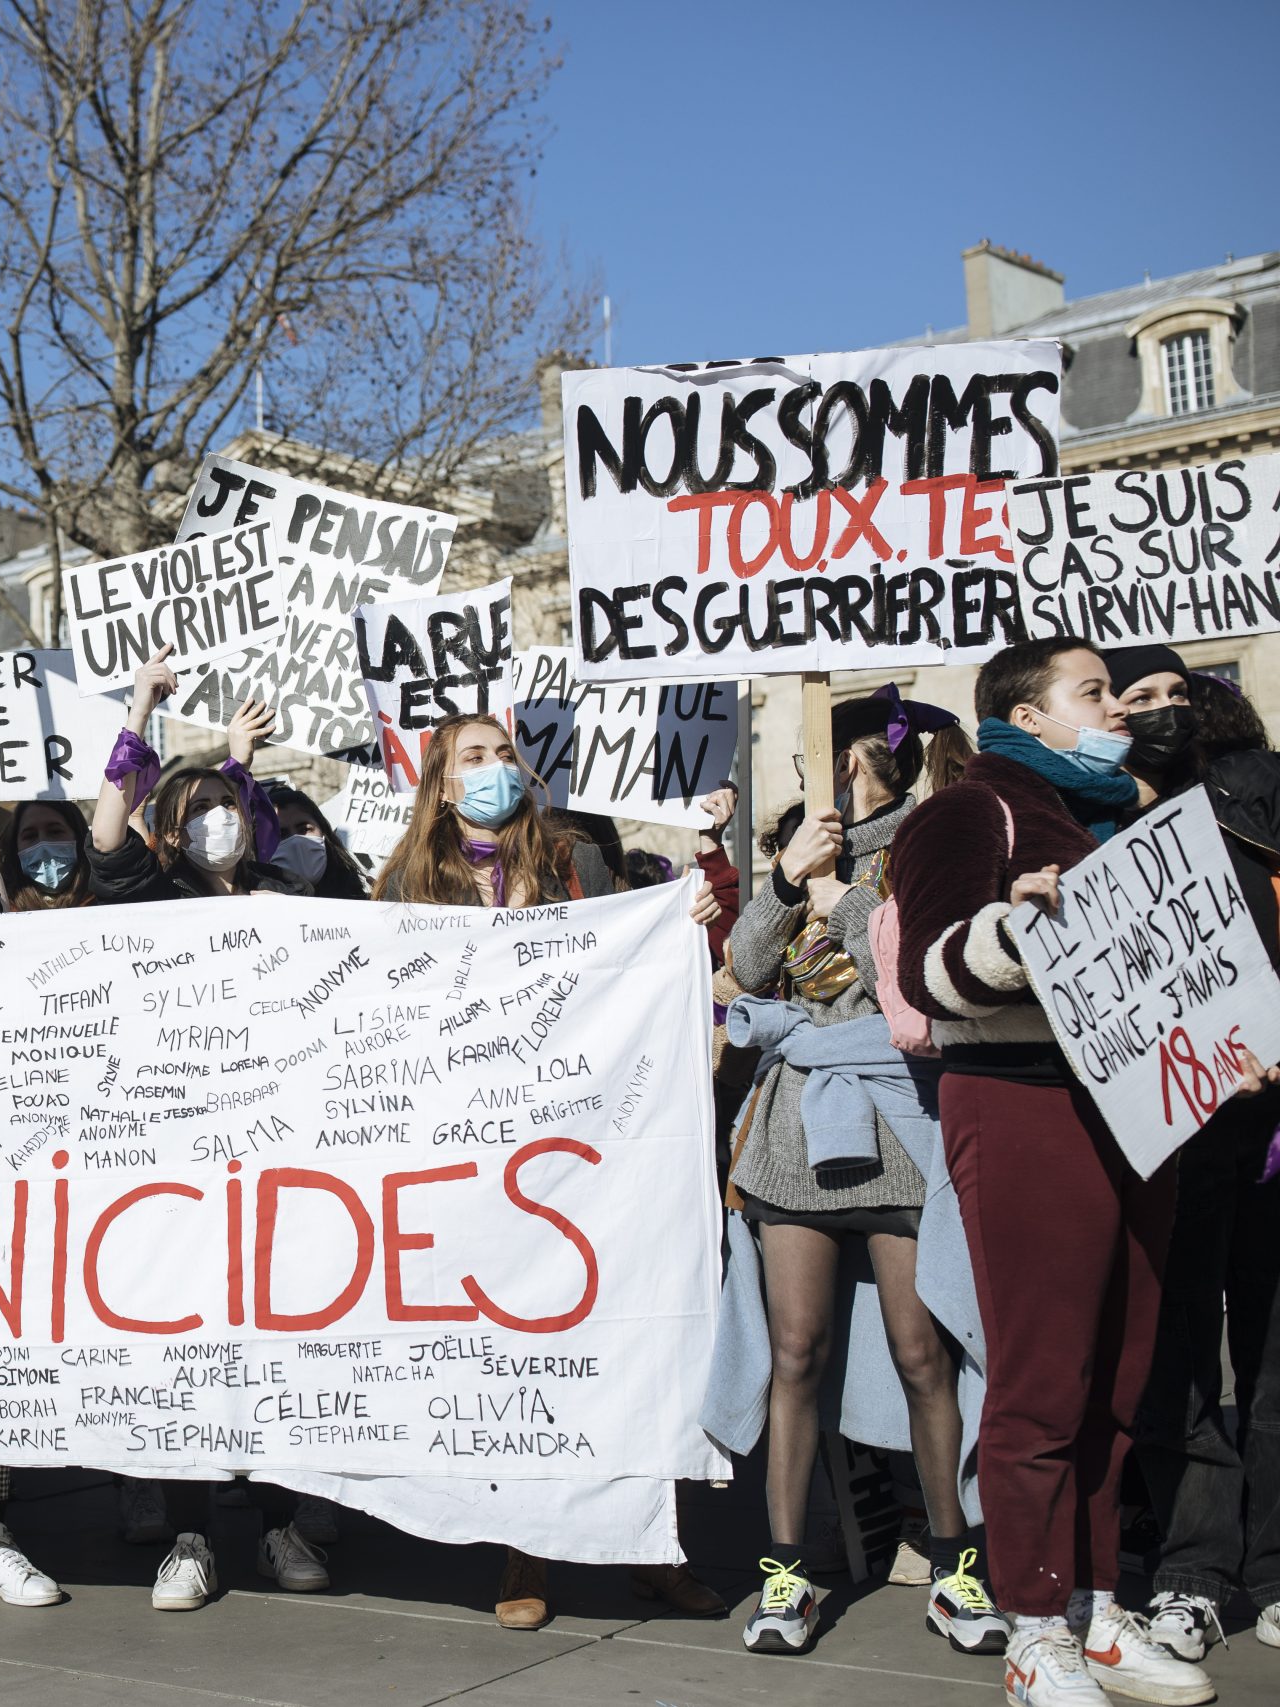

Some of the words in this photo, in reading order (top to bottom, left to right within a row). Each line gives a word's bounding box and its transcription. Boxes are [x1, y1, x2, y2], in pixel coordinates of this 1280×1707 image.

[576, 387, 776, 499] NOUS
[780, 370, 1059, 501] SOMMES
[197, 467, 277, 525] JE
[1011, 477, 1094, 545] JE
[70, 563, 132, 620] LE
[212, 522, 271, 581] EST
[1020, 534, 1123, 592] CAS
[1136, 522, 1242, 580] SUR
[580, 577, 688, 663] DES
[81, 612, 150, 677] UN
[356, 614, 428, 682] LA
[427, 600, 511, 676] RUE
[398, 666, 503, 730] EST
[516, 718, 709, 810] MAMAN
[396, 914, 472, 935] ANONYME
[492, 906, 569, 927] ANONYME
[1026, 910, 1081, 972] IL
[1073, 861, 1133, 941] M'A
[209, 927, 262, 953] LAURA
[25, 940, 94, 990] MATHILDE
[131, 951, 195, 979] MONICA
[387, 951, 438, 989] SARAH
[1051, 967, 1111, 1039] QUE
[1167, 880, 1216, 957] DE
[1205, 872, 1247, 929] LA
[297, 945, 370, 1019] ANONYME
[499, 972, 555, 1016] FATHIA
[40, 981, 113, 1016] TIFFANY
[143, 979, 238, 1018] SYLVIE
[249, 997, 299, 1016] CECILE
[1, 1016, 120, 1043] EMMANUELLE
[439, 998, 492, 1037] HILLARY
[511, 970, 580, 1064] FLORENCE
[157, 1026, 250, 1052] MYRIAM
[344, 1024, 411, 1059] AURORE
[447, 1035, 511, 1072] KARINA
[11, 1044, 108, 1065] MONIQUE
[221, 1056, 270, 1073] LORENA
[536, 1053, 592, 1083] LOLA
[97, 1055, 121, 1098] SYLVIE
[137, 1062, 210, 1078] ANONYME
[1158, 1026, 1217, 1128] 18
[12, 1093, 70, 1109] FOUAD
[121, 1085, 186, 1101] YASEMIN
[207, 1082, 280, 1113] BARBARA
[467, 1084, 536, 1109] ANNE
[612, 1054, 655, 1134] ANONYME
[10, 1113, 71, 1127] ANONYME
[80, 1105, 161, 1123] NATHALIE
[78, 1123, 147, 1142] ANONYME
[190, 1115, 295, 1162] SALMA
[315, 1122, 411, 1150] ANONYME
[432, 1118, 517, 1145] GRÂCE
[83, 1148, 157, 1170] MANON
[61, 1348, 133, 1368] CARINE
[163, 1343, 243, 1363] ANONYME
[409, 1335, 495, 1362] JOËLLE
[173, 1361, 287, 1389] AURÉLIE
[353, 1365, 435, 1383] NATACHA
[480, 1355, 600, 1378] SÉVERINE
[81, 1385, 197, 1411] FRANCIELE
[75, 1412, 137, 1427] ANONYME
[289, 1423, 410, 1446] STEPHANIE
[126, 1421, 266, 1454] STÉPHANIE
[429, 1428, 596, 1458] ALEXANDRA
